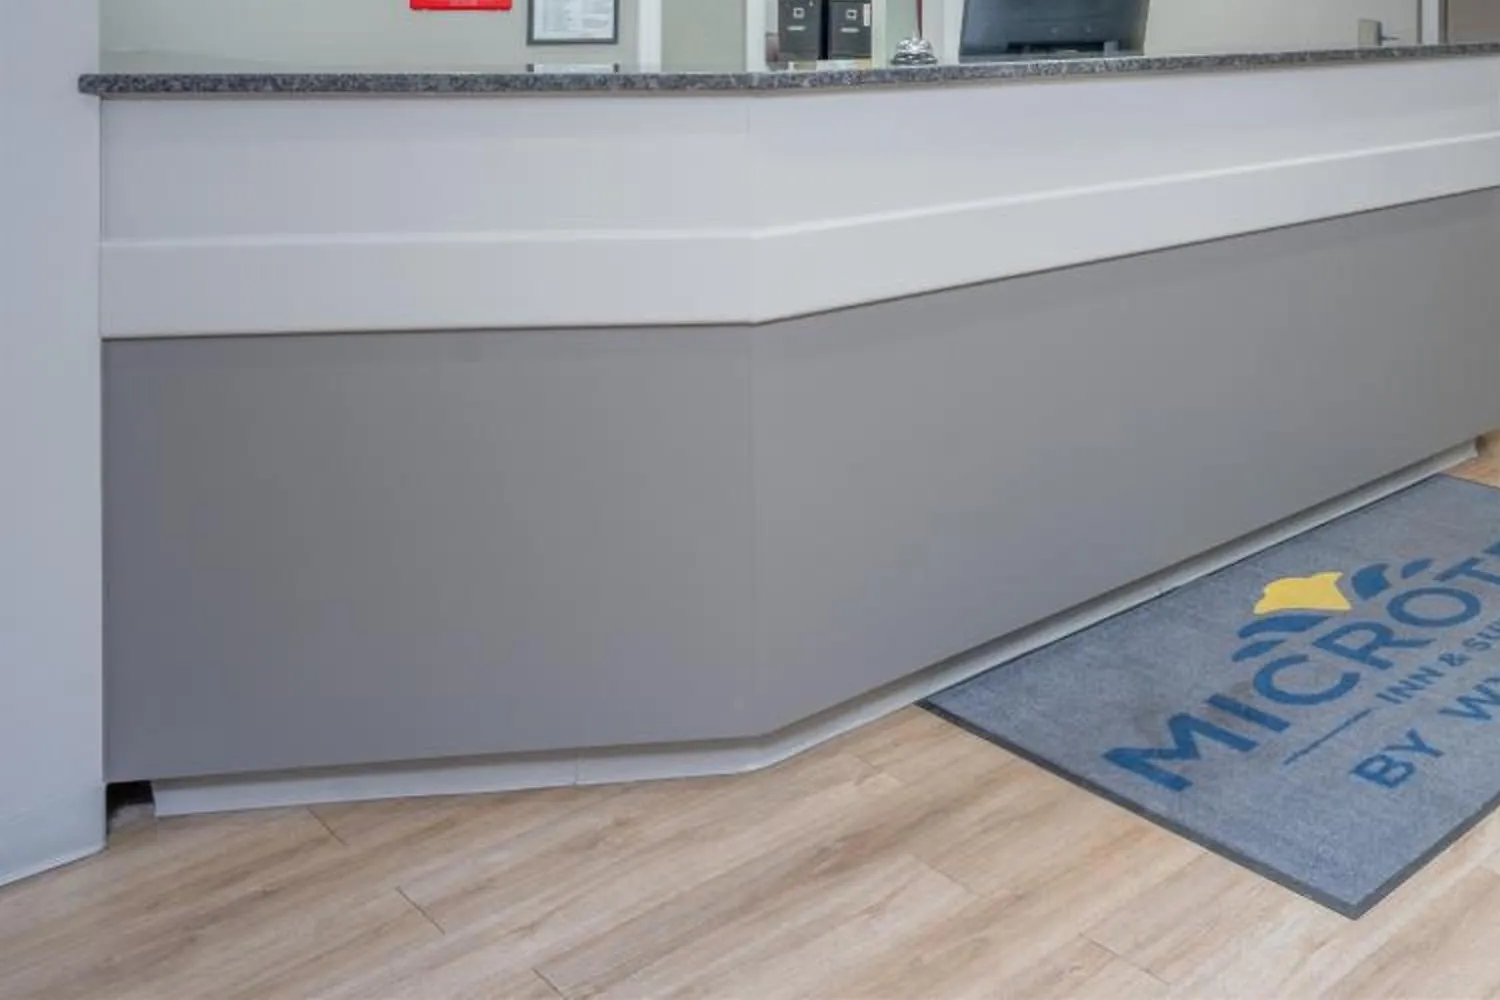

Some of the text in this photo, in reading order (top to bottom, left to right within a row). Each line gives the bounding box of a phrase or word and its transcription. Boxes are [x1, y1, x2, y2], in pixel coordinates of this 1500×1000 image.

[1375, 666, 1445, 705] INN
[1438, 651, 1472, 668] &
[1348, 728, 1446, 789] BY
